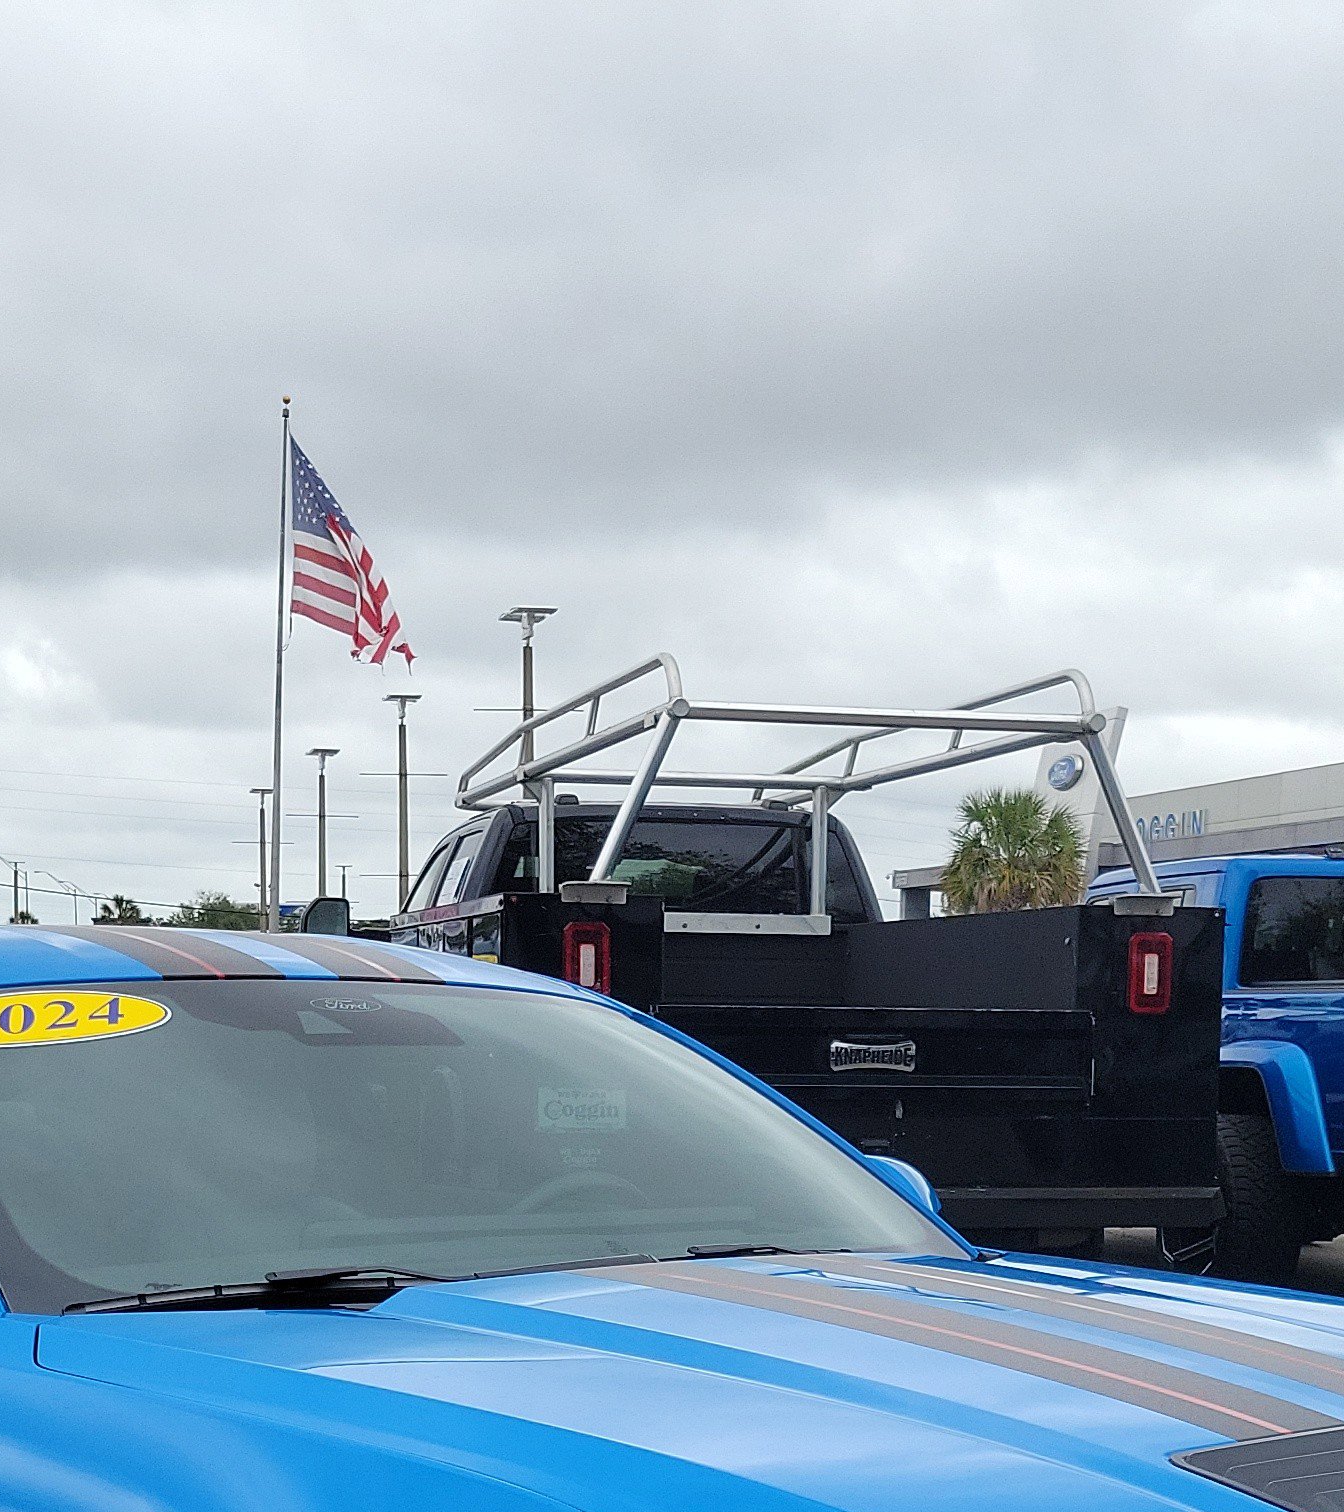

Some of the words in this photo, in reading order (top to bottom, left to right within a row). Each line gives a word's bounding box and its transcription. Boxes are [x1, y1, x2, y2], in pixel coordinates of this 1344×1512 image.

[1136, 809, 1204, 841] OGGIN
[324, 997, 371, 1011] Ford
[544, 1099, 618, 1120] Coggin
